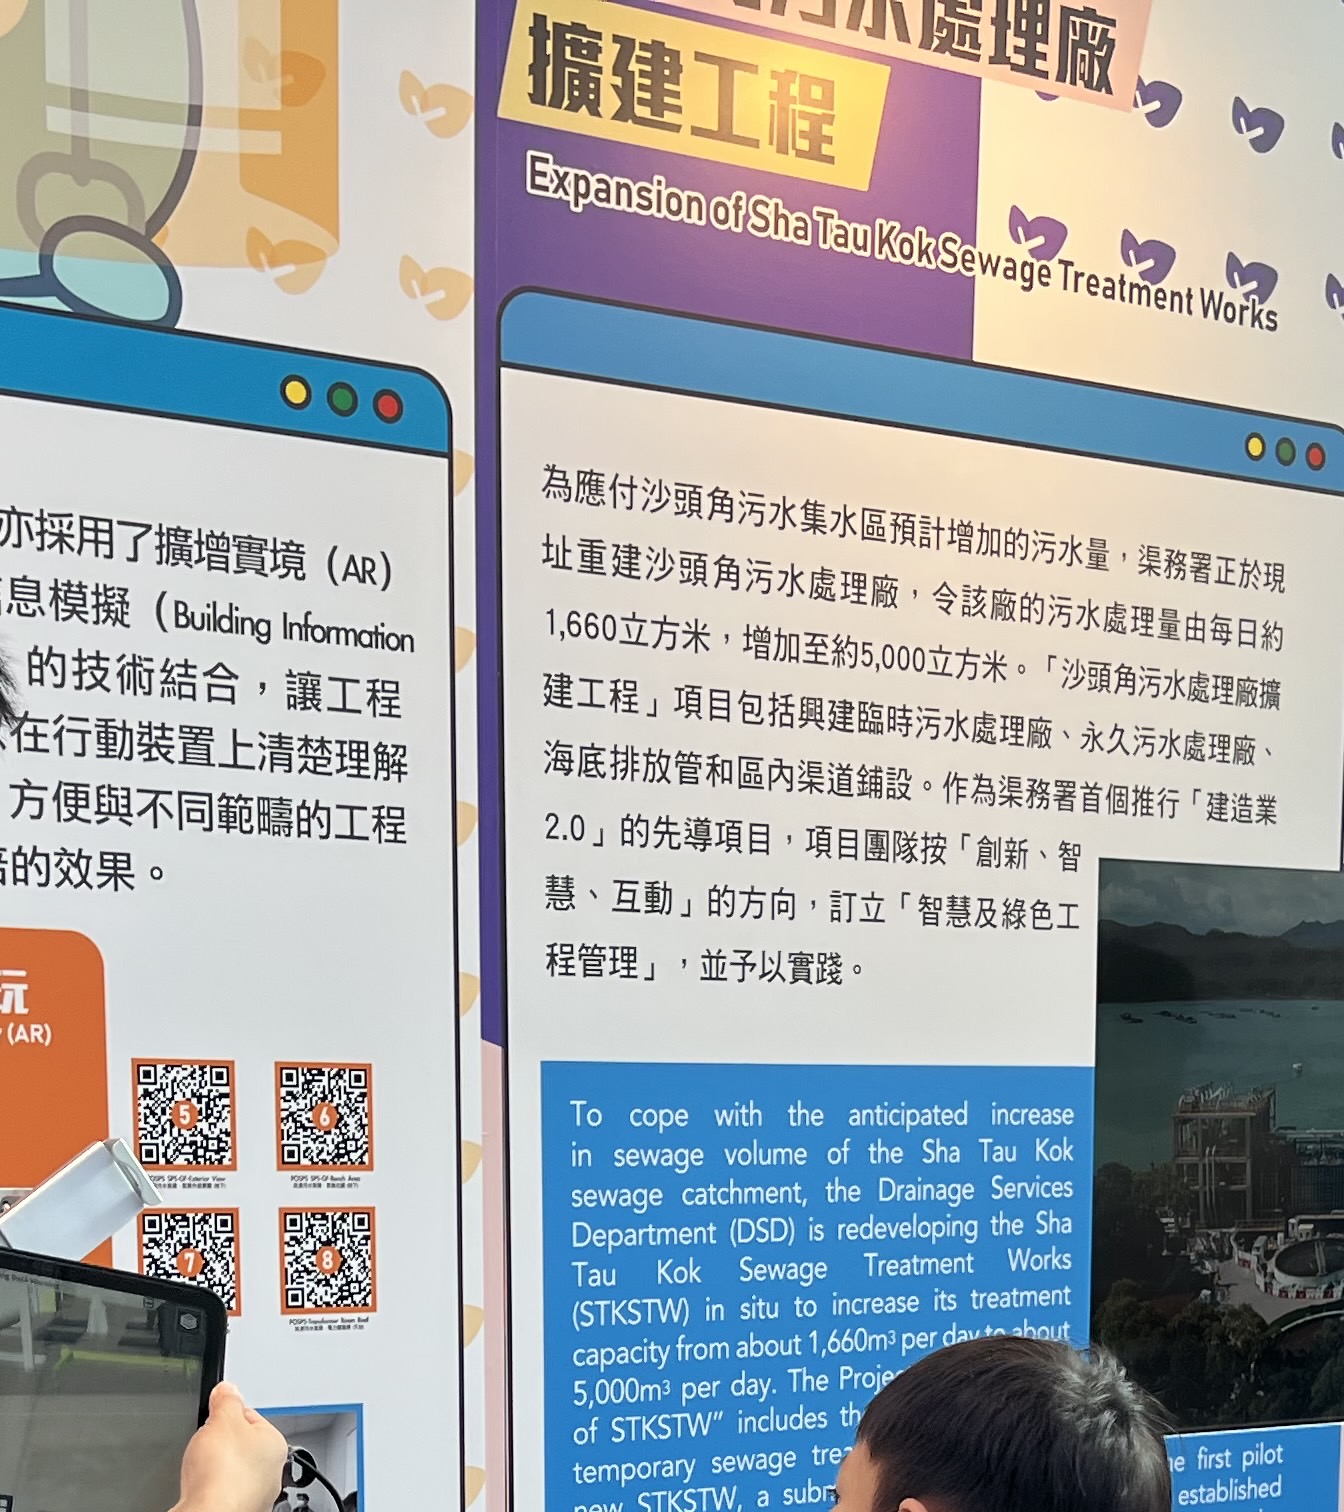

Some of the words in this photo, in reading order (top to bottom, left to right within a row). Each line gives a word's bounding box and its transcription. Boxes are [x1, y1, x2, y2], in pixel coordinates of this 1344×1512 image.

[528, 14, 836, 166] 擴建工程
[530, 155, 703, 222] Expansion
[713, 196, 743, 227] of
[751, 199, 809, 241] Sha
[815, 210, 868, 253] Tau
[877, 220, 932, 264] Kok
[939, 237, 1050, 292] Sewage
[1058, 260, 1193, 315] Treatment
[1200, 287, 1277, 332] Works
[282, 610, 415, 653] Information
[6, 1022, 52, 1047] (AR)
[178, 1105, 191, 1126] 5
[318, 1106, 331, 1127] 6
[570, 1100, 602, 1126] To
[630, 1109, 688, 1133] cope
[714, 1100, 762, 1126] with
[788, 1100, 824, 1126] the
[849, 1100, 968, 1133] anticipated
[992, 1102, 1074, 1125] increase
[572, 1141, 591, 1167] in
[614, 1148, 704, 1174] sewage
[724, 1139, 807, 1165] volume
[828, 1138, 851, 1164] of
[868, 1138, 903, 1164] the
[922, 1138, 960, 1163] Sha
[978, 1138, 1016, 1162] Tau
[1036, 1136, 1074, 1161] Kok
[572, 1188, 663, 1214] sewage
[682, 1178, 807, 1207] catchment,
[825, 1176, 861, 1203] the
[879, 1177, 974, 1207] Drainage
[992, 1175, 1073, 1199] Services
[573, 1222, 717, 1254] Department
[730, 1217, 795, 1247] (DSD)
[809, 1217, 824, 1241] is
[838, 1213, 978, 1244] redeveloping
[990, 1210, 1024, 1236] the
[1036, 1209, 1072, 1235] Sha
[183, 1252, 195, 1273] 7
[322, 1250, 334, 1270] 8
[571, 1262, 616, 1287] Tau
[658, 1257, 701, 1284] Kok
[740, 1256, 827, 1287] Sewage
[863, 1253, 974, 1277] Treatment
[1008, 1245, 1072, 1271] Works
[573, 1297, 689, 1331] (STKSTW)
[706, 1297, 724, 1321] in
[740, 1295, 778, 1320] situ
[794, 1296, 817, 1317] to
[833, 1292, 919, 1315] increase
[934, 1288, 957, 1311] its
[970, 1285, 1071, 1309] treatment
